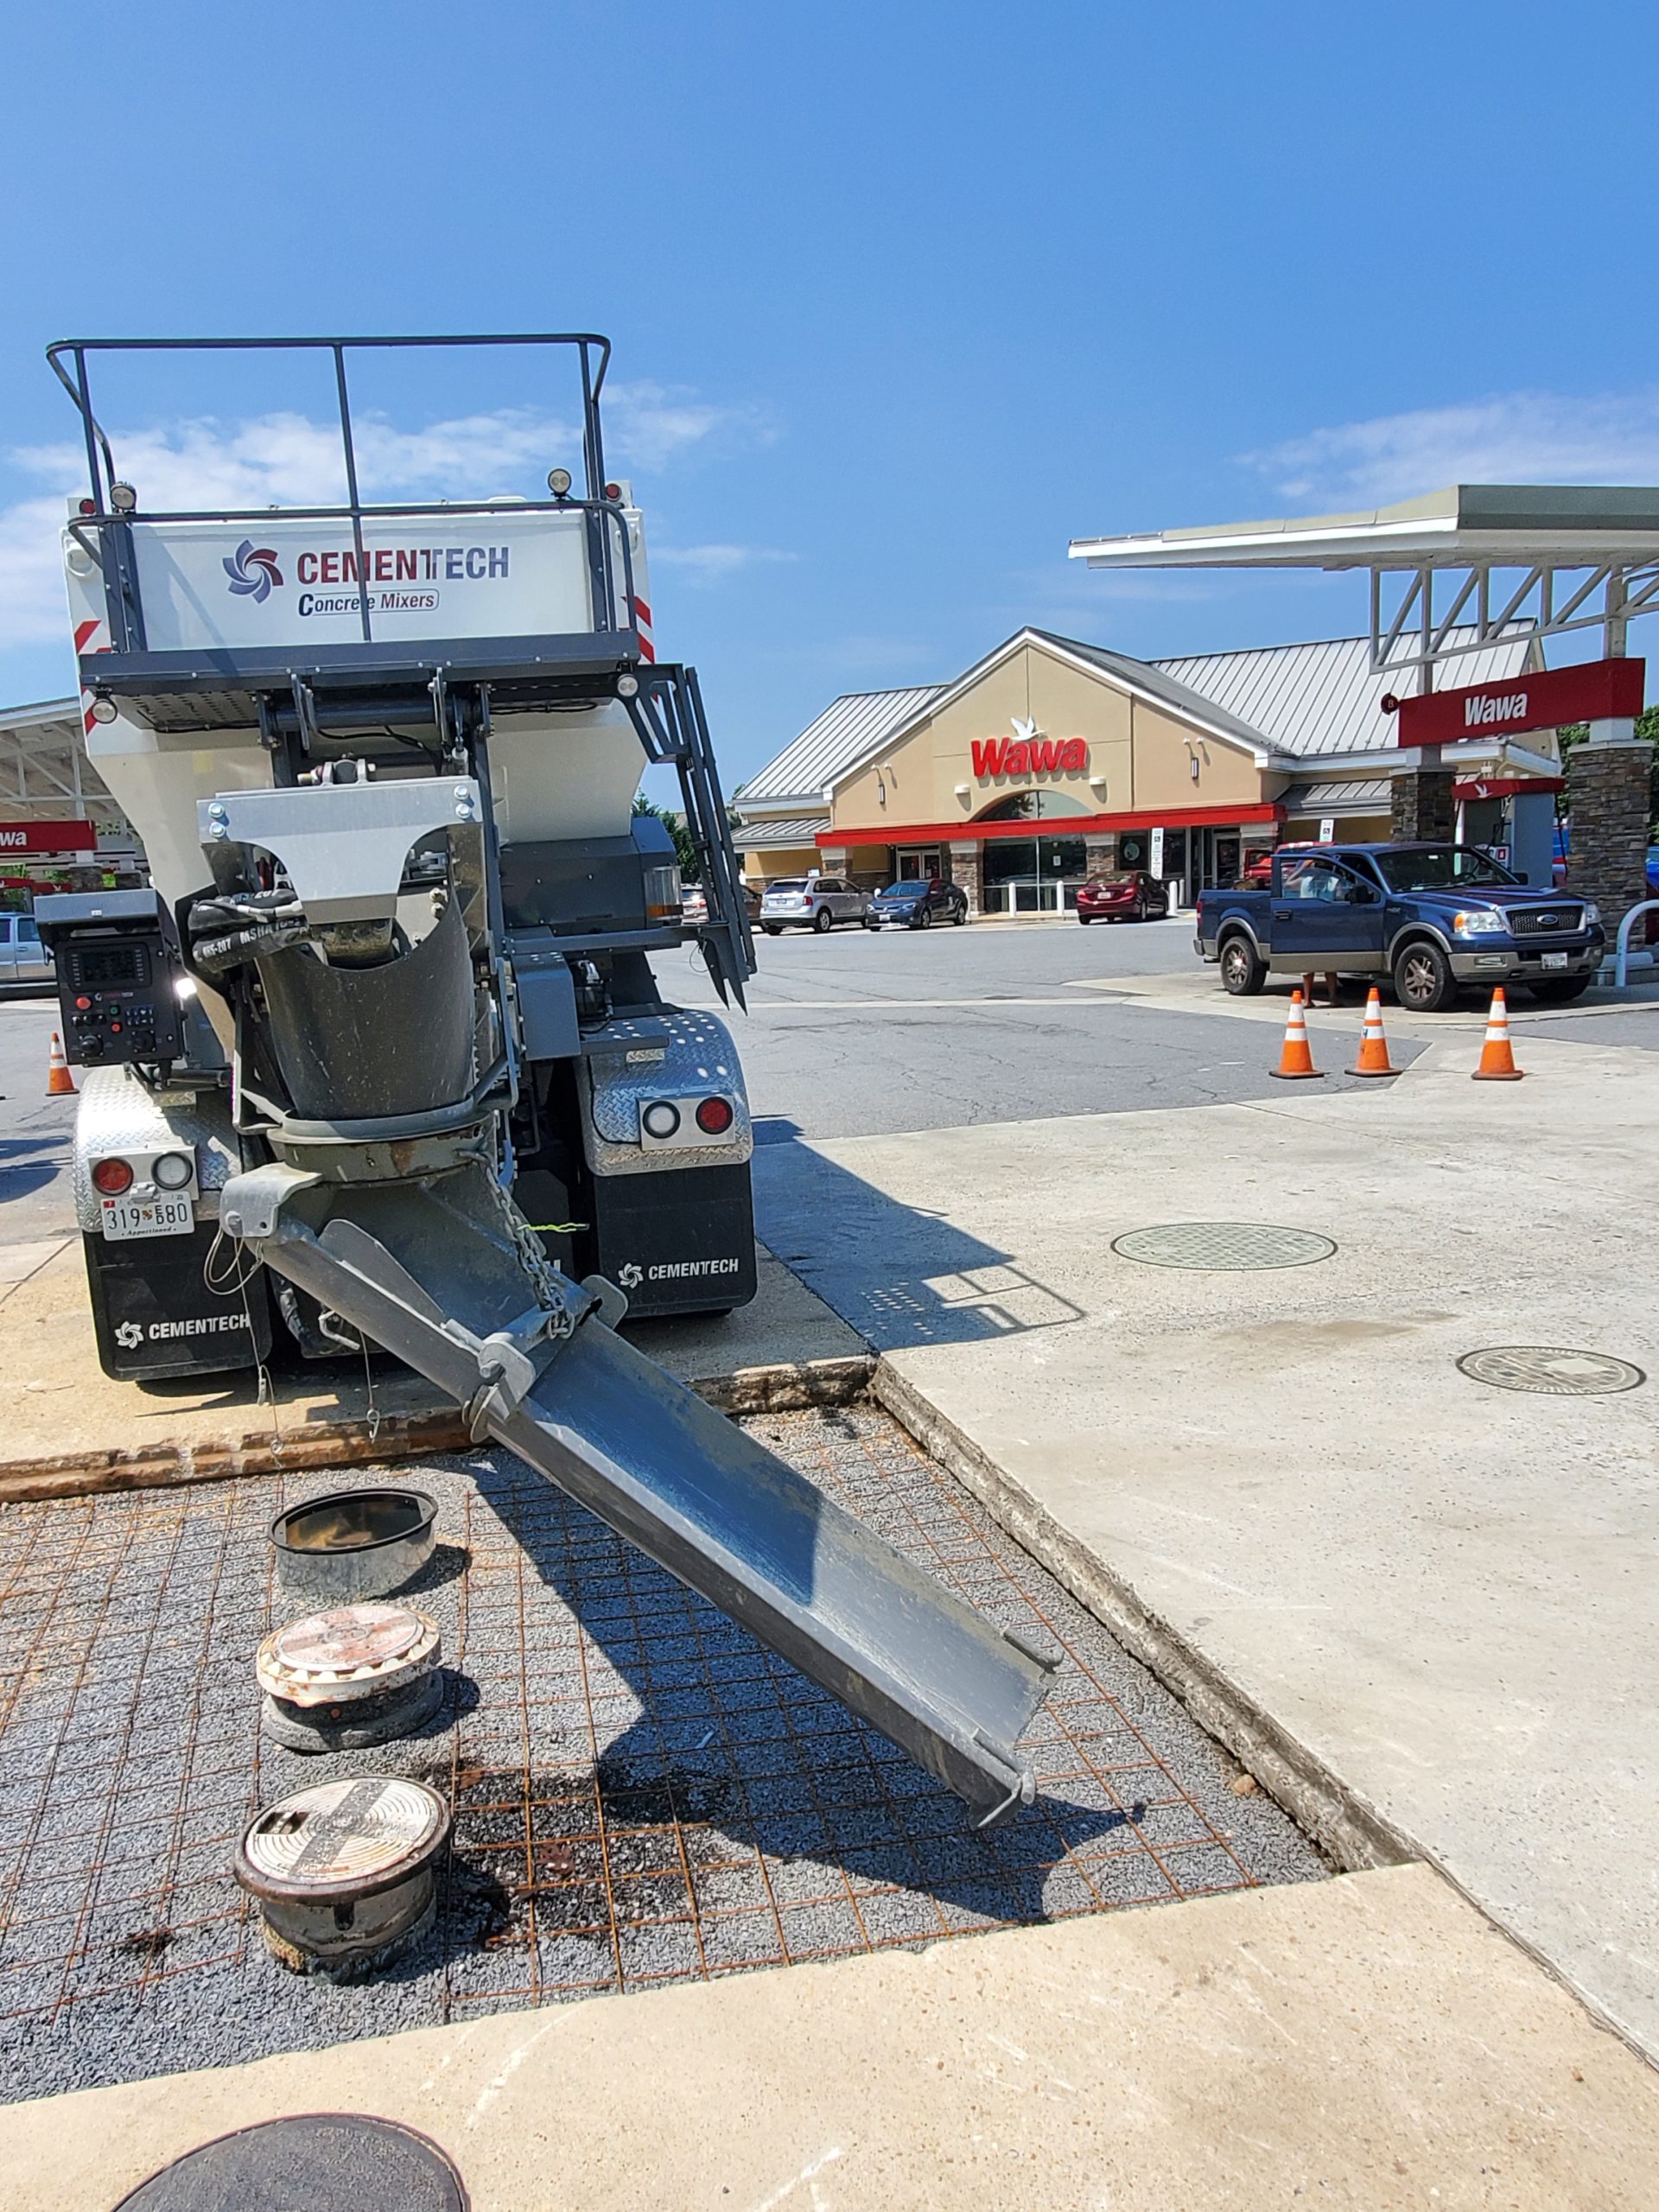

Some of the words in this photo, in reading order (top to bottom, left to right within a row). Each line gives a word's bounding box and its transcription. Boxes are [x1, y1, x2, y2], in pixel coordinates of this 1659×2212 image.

[298, 594, 376, 617] Concree
[380, 590, 435, 609] Mixers
[1465, 693, 1528, 727] Wawa
[970, 736, 1087, 778] Wawa
